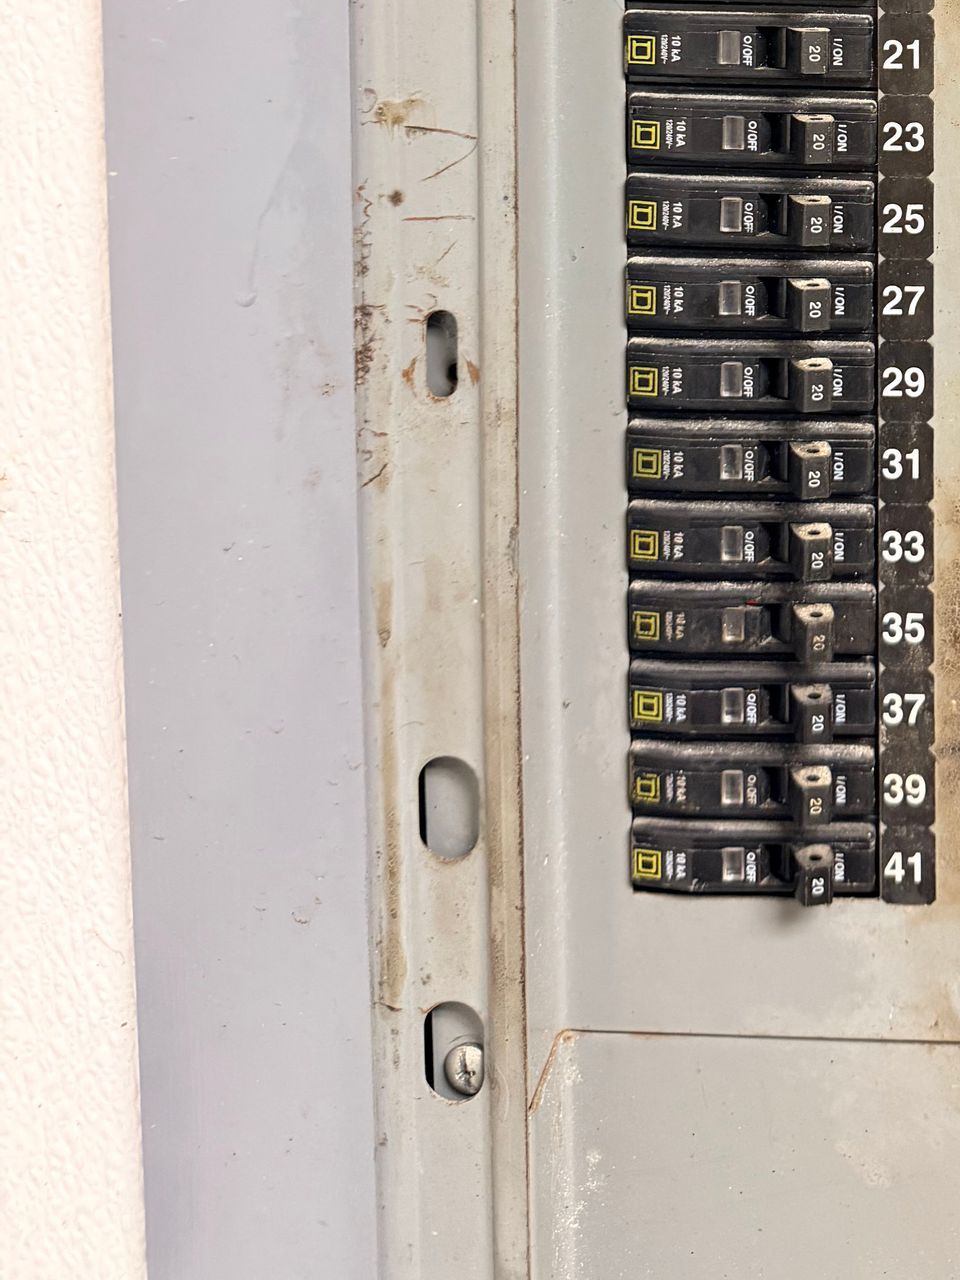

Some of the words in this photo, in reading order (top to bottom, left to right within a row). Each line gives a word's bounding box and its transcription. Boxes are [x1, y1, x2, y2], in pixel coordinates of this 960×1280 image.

[809, 45, 820, 62] 20
[883, 39, 920, 70] 21
[813, 134, 824, 150] 20
[883, 122, 925, 151] 23
[811, 217, 822, 233] 20
[883, 204, 925, 233] 25
[809, 301, 821, 318] 20
[882, 286, 925, 315] 27
[812, 384, 823, 401] 20
[882, 367, 925, 398] 29
[882, 449, 920, 479] 31
[809, 471, 820, 487] 20
[812, 552, 823, 569] 20
[882, 531, 924, 561] 33
[882, 613, 925, 643] 35
[813, 715, 824, 732] 20
[883, 693, 925, 725] 37
[884, 774, 926, 805] 39
[809, 799, 821, 815] 20
[884, 853, 922, 883] 41
[812, 879, 824, 896] 20
